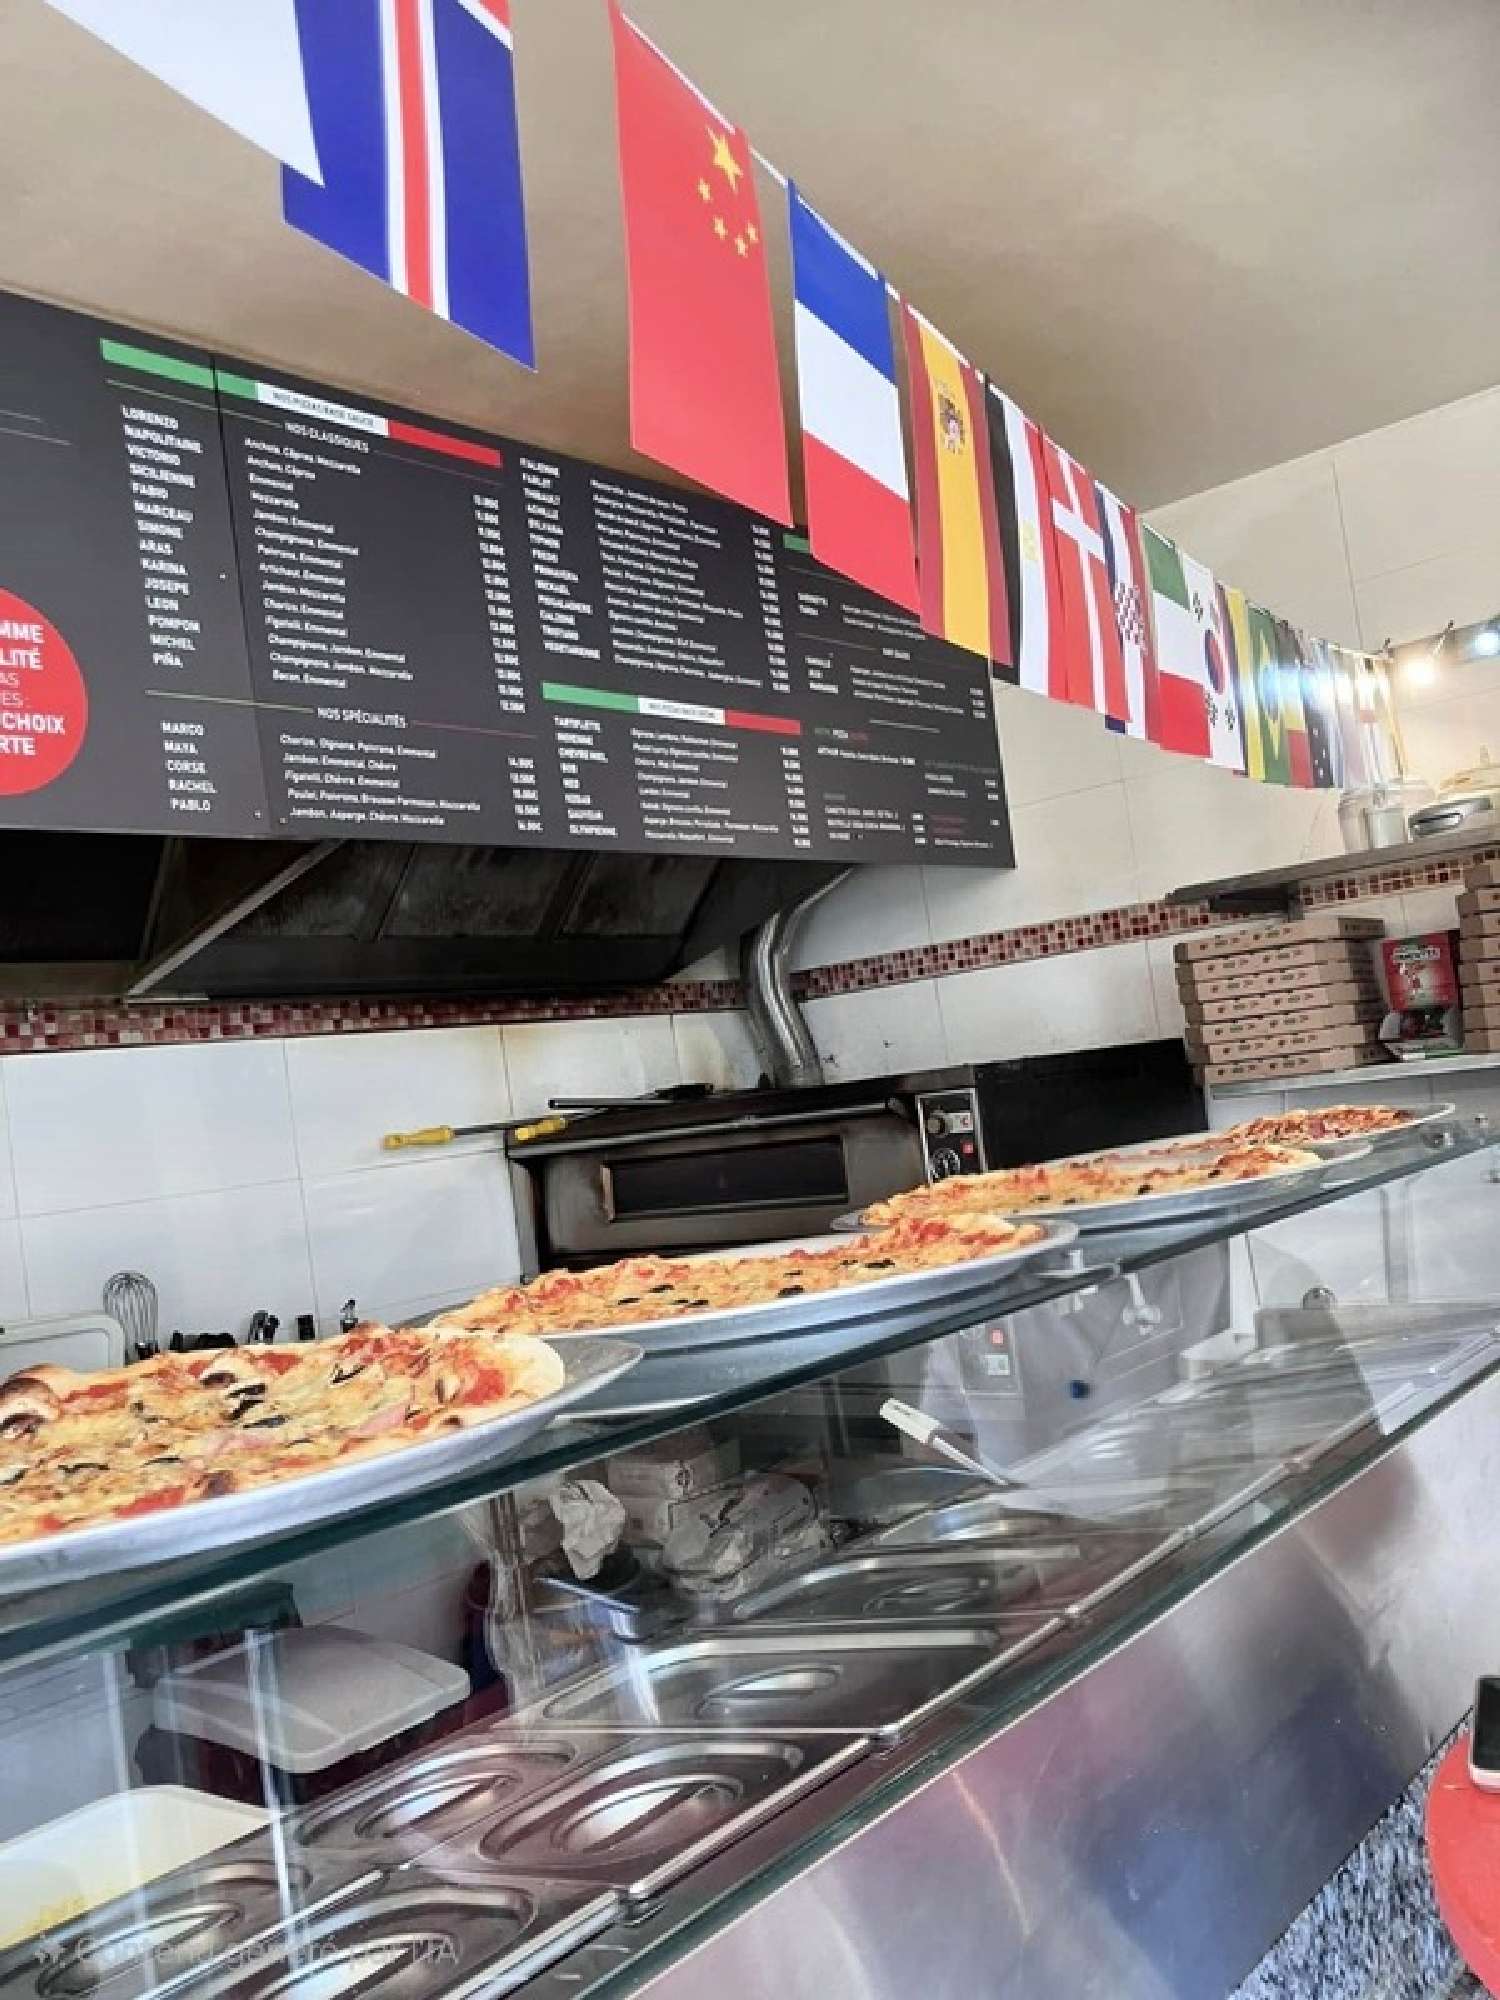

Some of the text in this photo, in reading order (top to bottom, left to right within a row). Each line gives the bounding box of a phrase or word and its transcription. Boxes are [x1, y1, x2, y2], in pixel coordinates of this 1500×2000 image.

[123, 406, 178, 430] LORENZO
[123, 425, 203, 453] NAPOLITAINE
[309, 427, 369, 454] CLASSIQUES
[128, 444, 180, 465] VICTORIO
[130, 463, 195, 488] SICILIENNE
[133, 482, 168, 499] FABIO
[135, 500, 193, 523] MARCEAU
[138, 520, 183, 538] SIMONE
[140, 540, 173, 555] ARAS
[141, 558, 188, 575] KARINA
[150, 634, 195, 650] MICHEL
[0, 647, 43, 670] LITÉ
[1, 713, 66, 735] CHOIX
[318, 708, 405, 728] NOS SPÉCIALITÉS
[161, 722, 203, 735] MARCO
[165, 740, 198, 754] MAYA
[166, 760, 205, 773] CORSE
[168, 779, 217, 793] RACHEL
[170, 798, 210, 810] PABLO
